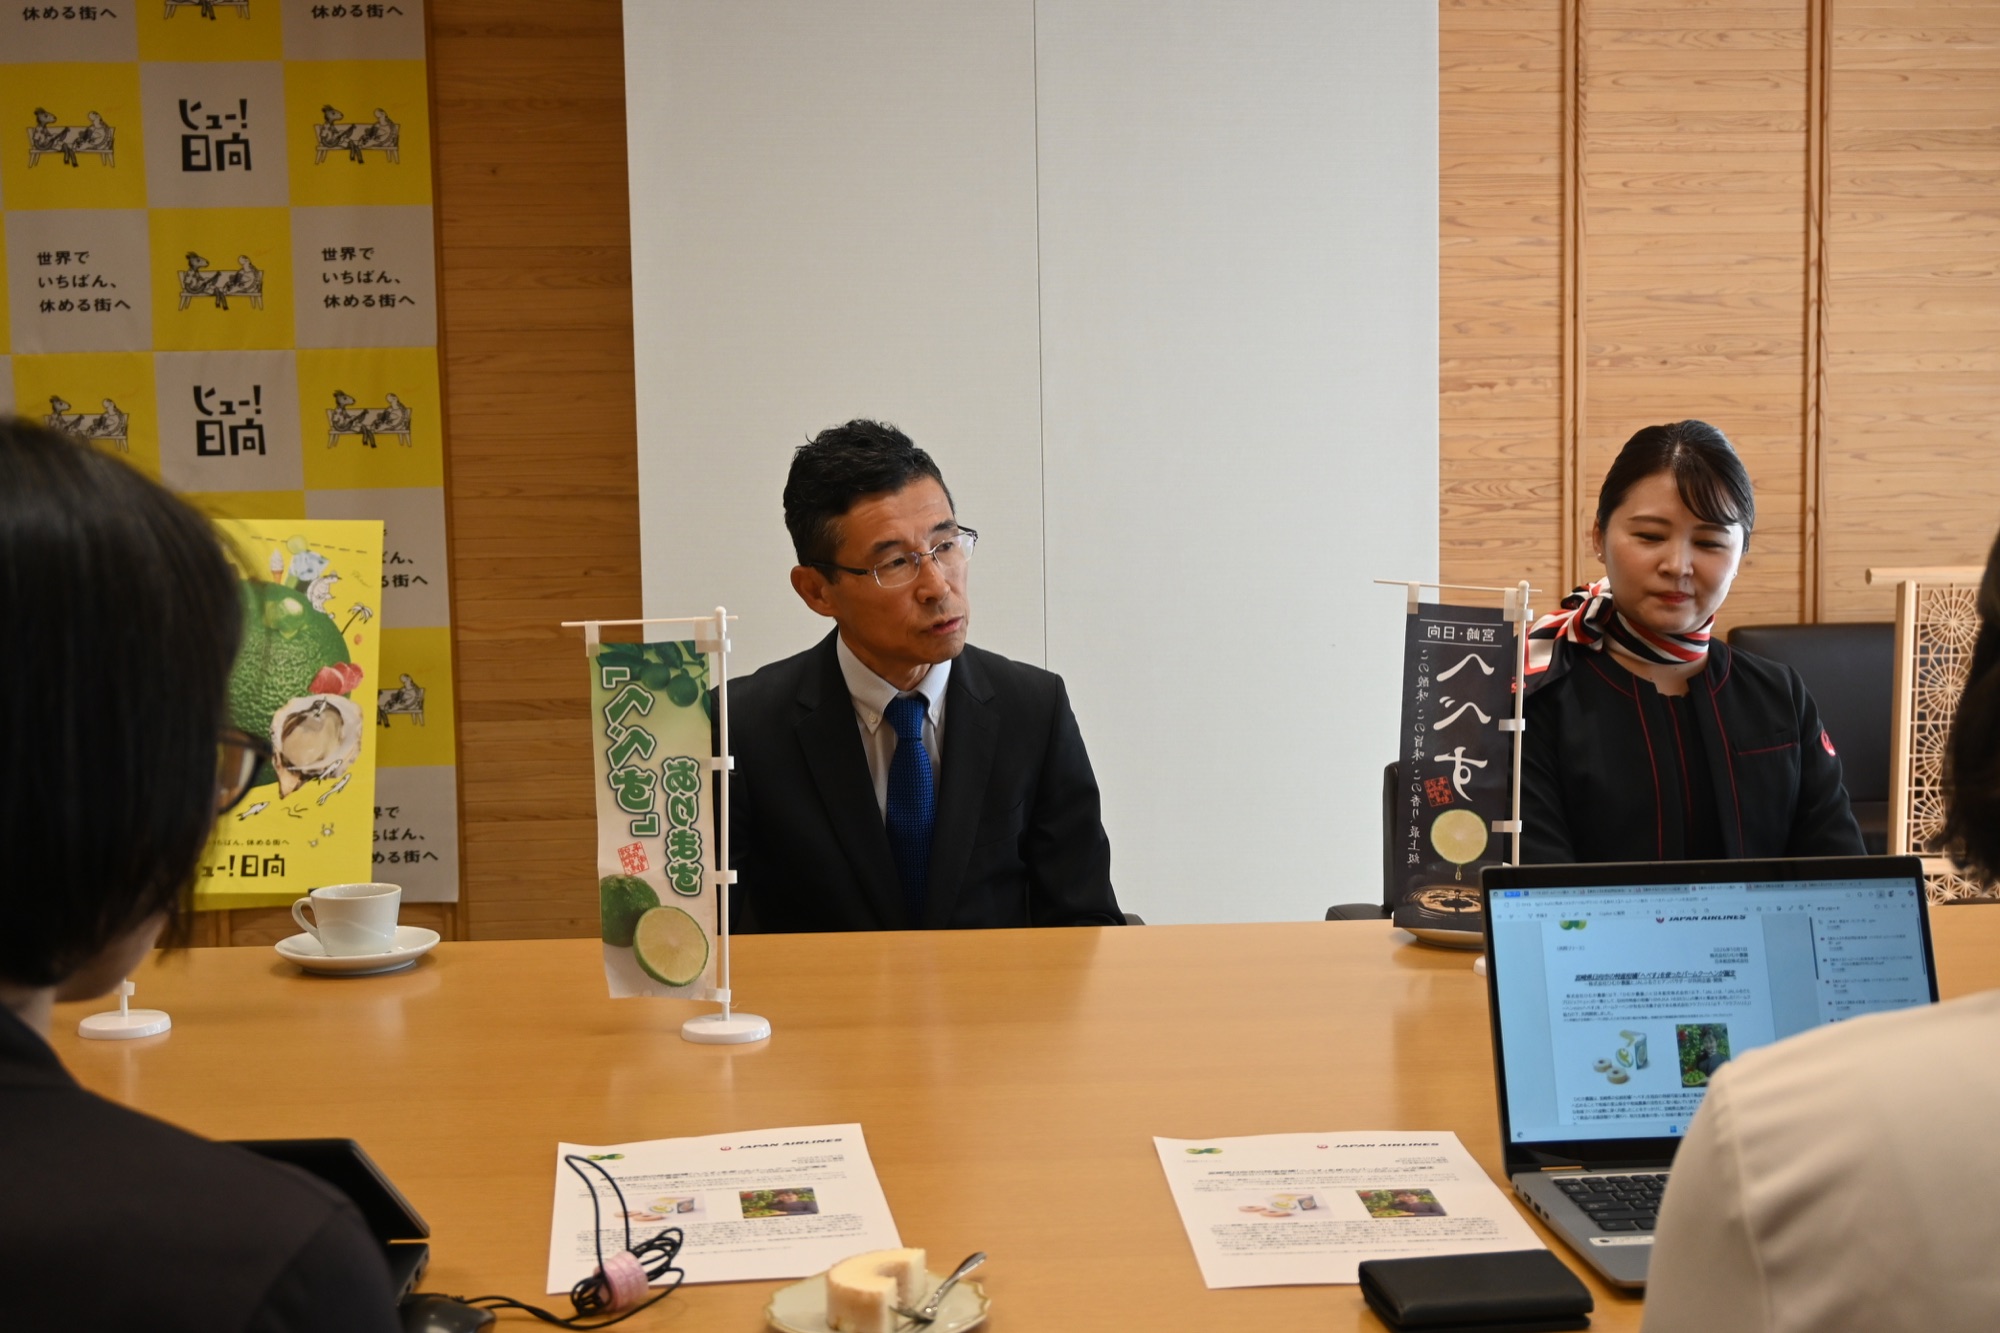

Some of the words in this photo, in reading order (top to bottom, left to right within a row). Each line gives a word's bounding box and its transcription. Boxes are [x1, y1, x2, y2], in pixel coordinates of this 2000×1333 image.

[22, 6, 117, 21] 休める街へ
[311, 4, 403, 19] 休める街へ
[178, 98, 248, 131] ヒュー!
[181, 133, 252, 172] 日向
[36, 250, 90, 266] 世界で
[321, 246, 375, 262] 世界で
[37, 274, 117, 290] いちばん、
[322, 270, 402, 286] いちばん、
[39, 297, 131, 313] 休める街へ
[323, 293, 415, 309] 休める街へ
[193, 385, 262, 416] ヒュー!
[195, 418, 266, 457] 日向
[737, 1142, 779, 1150] JAPAN
[782, 1138, 843, 1147] AIRLINES
